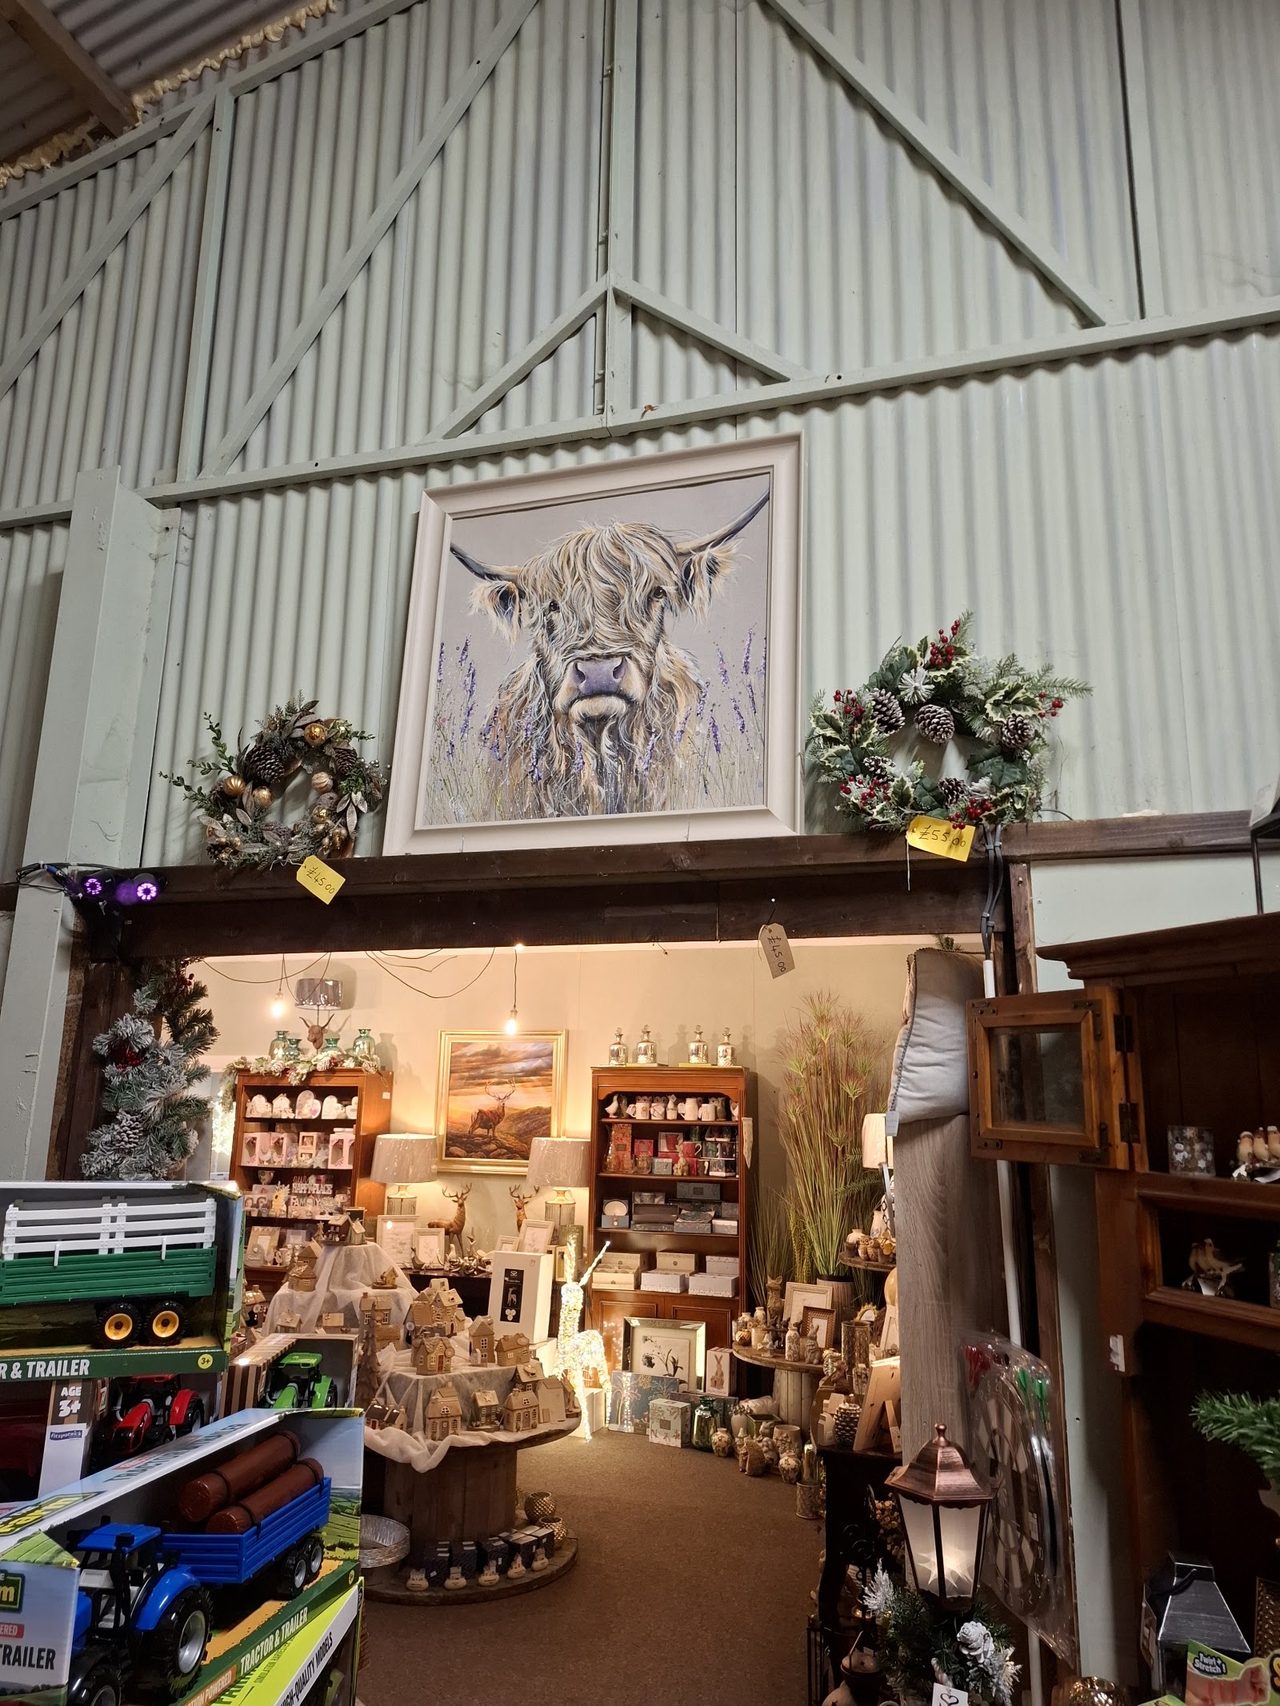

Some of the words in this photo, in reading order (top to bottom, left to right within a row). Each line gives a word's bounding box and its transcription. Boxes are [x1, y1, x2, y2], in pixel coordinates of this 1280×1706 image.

[10, 1362, 23, 1379] &
[26, 1358, 91, 1378] TRAILER
[60, 1386, 82, 1397] AGE
[58, 1399, 82, 1418] 3+
[240, 1633, 274, 1677] TRACTOR
[281, 1606, 309, 1642] TRAILER
